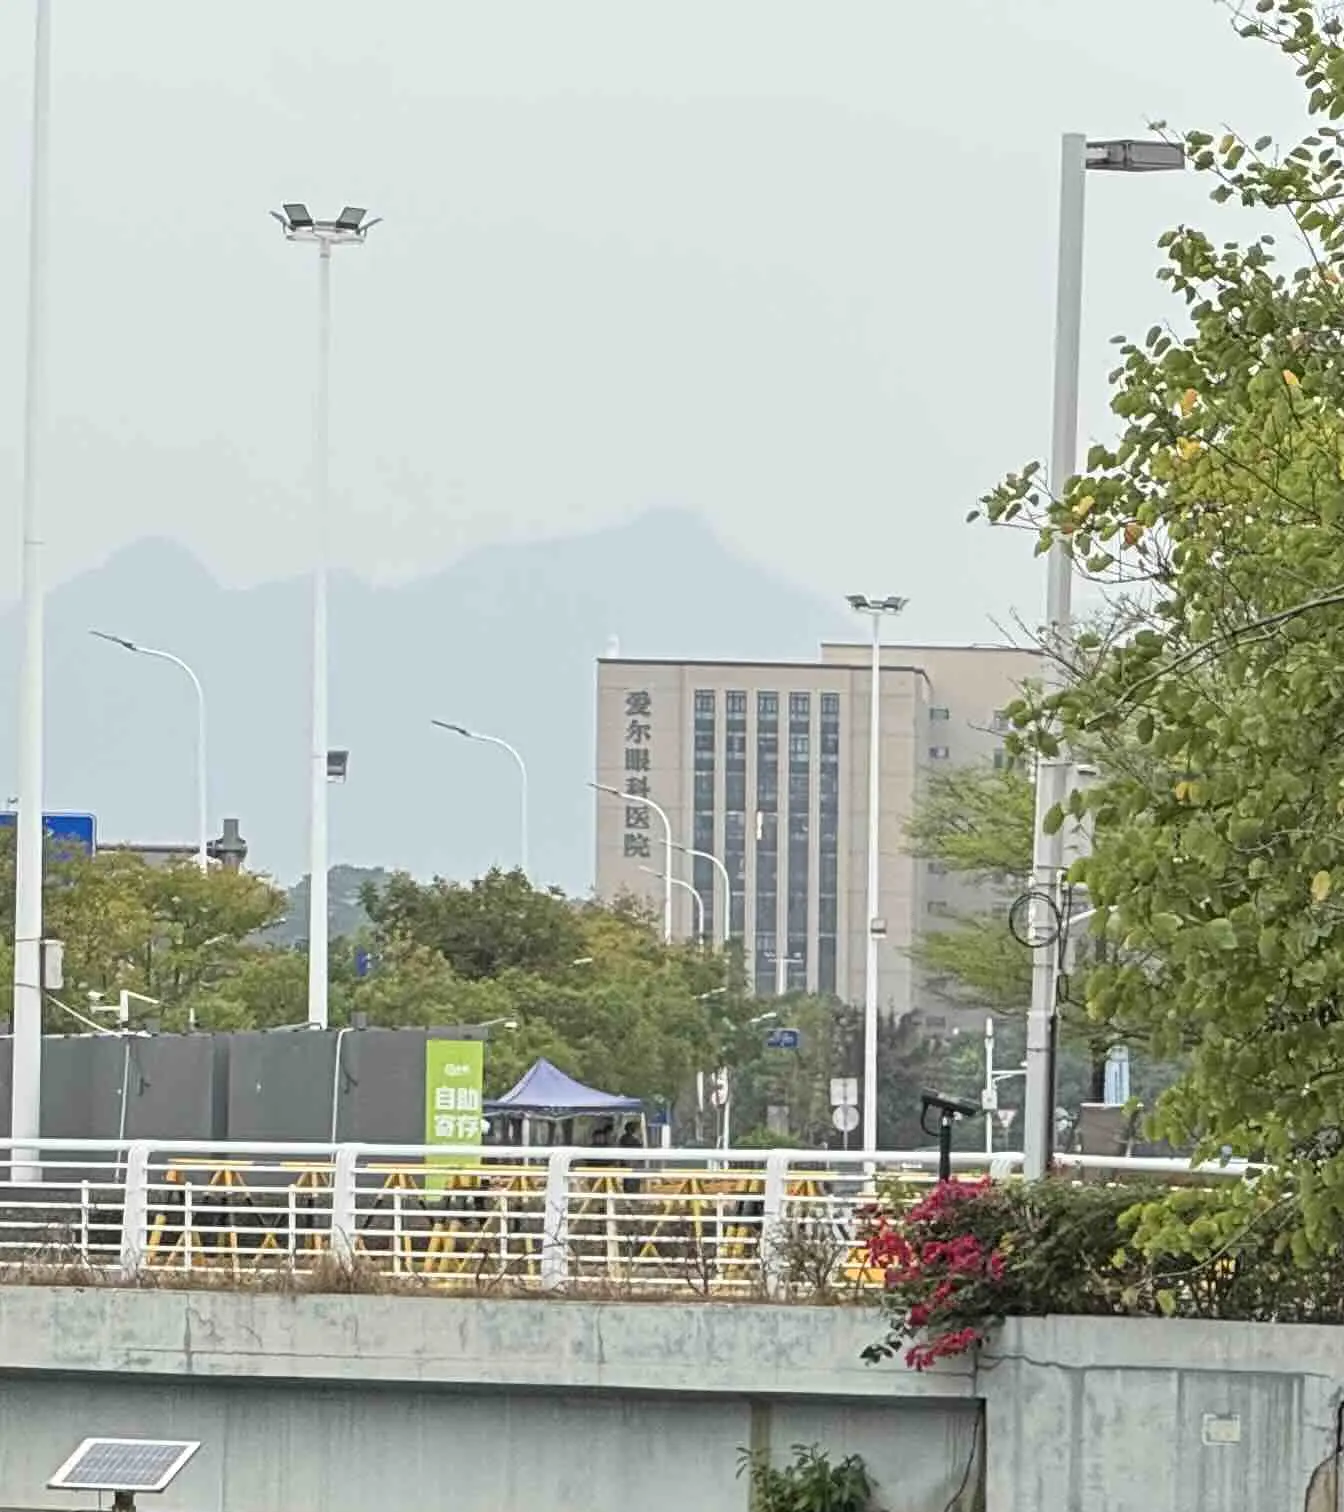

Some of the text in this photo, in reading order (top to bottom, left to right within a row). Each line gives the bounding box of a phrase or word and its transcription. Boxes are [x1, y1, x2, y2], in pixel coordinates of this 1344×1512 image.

[624, 690, 651, 858] 爱尔眼科医院
[435, 1086, 479, 1110] 自助
[434, 1114, 480, 1138] 寄存
